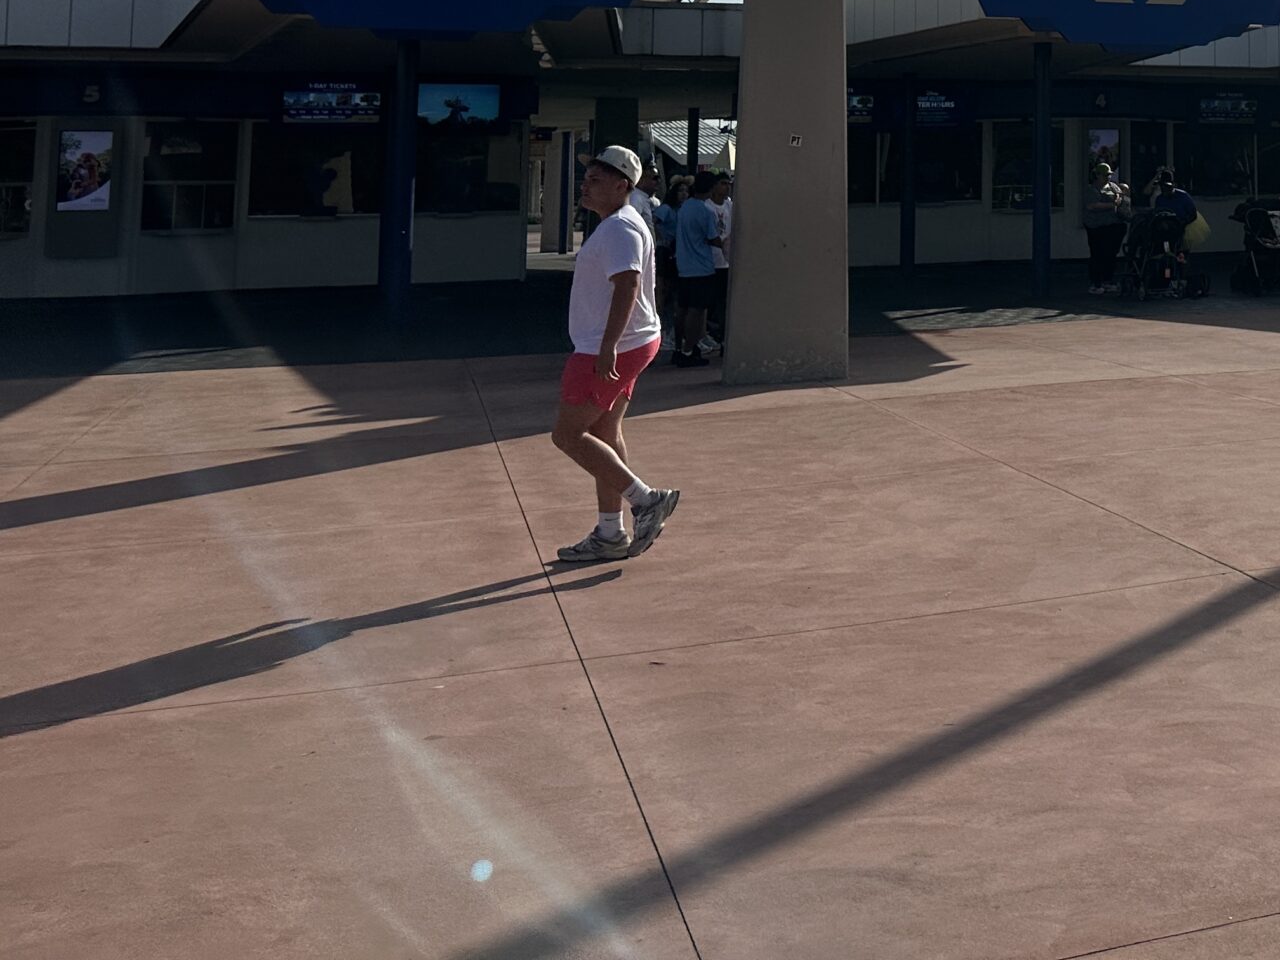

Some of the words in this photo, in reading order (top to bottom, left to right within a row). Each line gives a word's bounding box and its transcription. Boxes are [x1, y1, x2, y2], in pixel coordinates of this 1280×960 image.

[82, 84, 101, 103] 5
[1095, 93, 1107, 108] 4
[790, 136, 801, 145] PT
